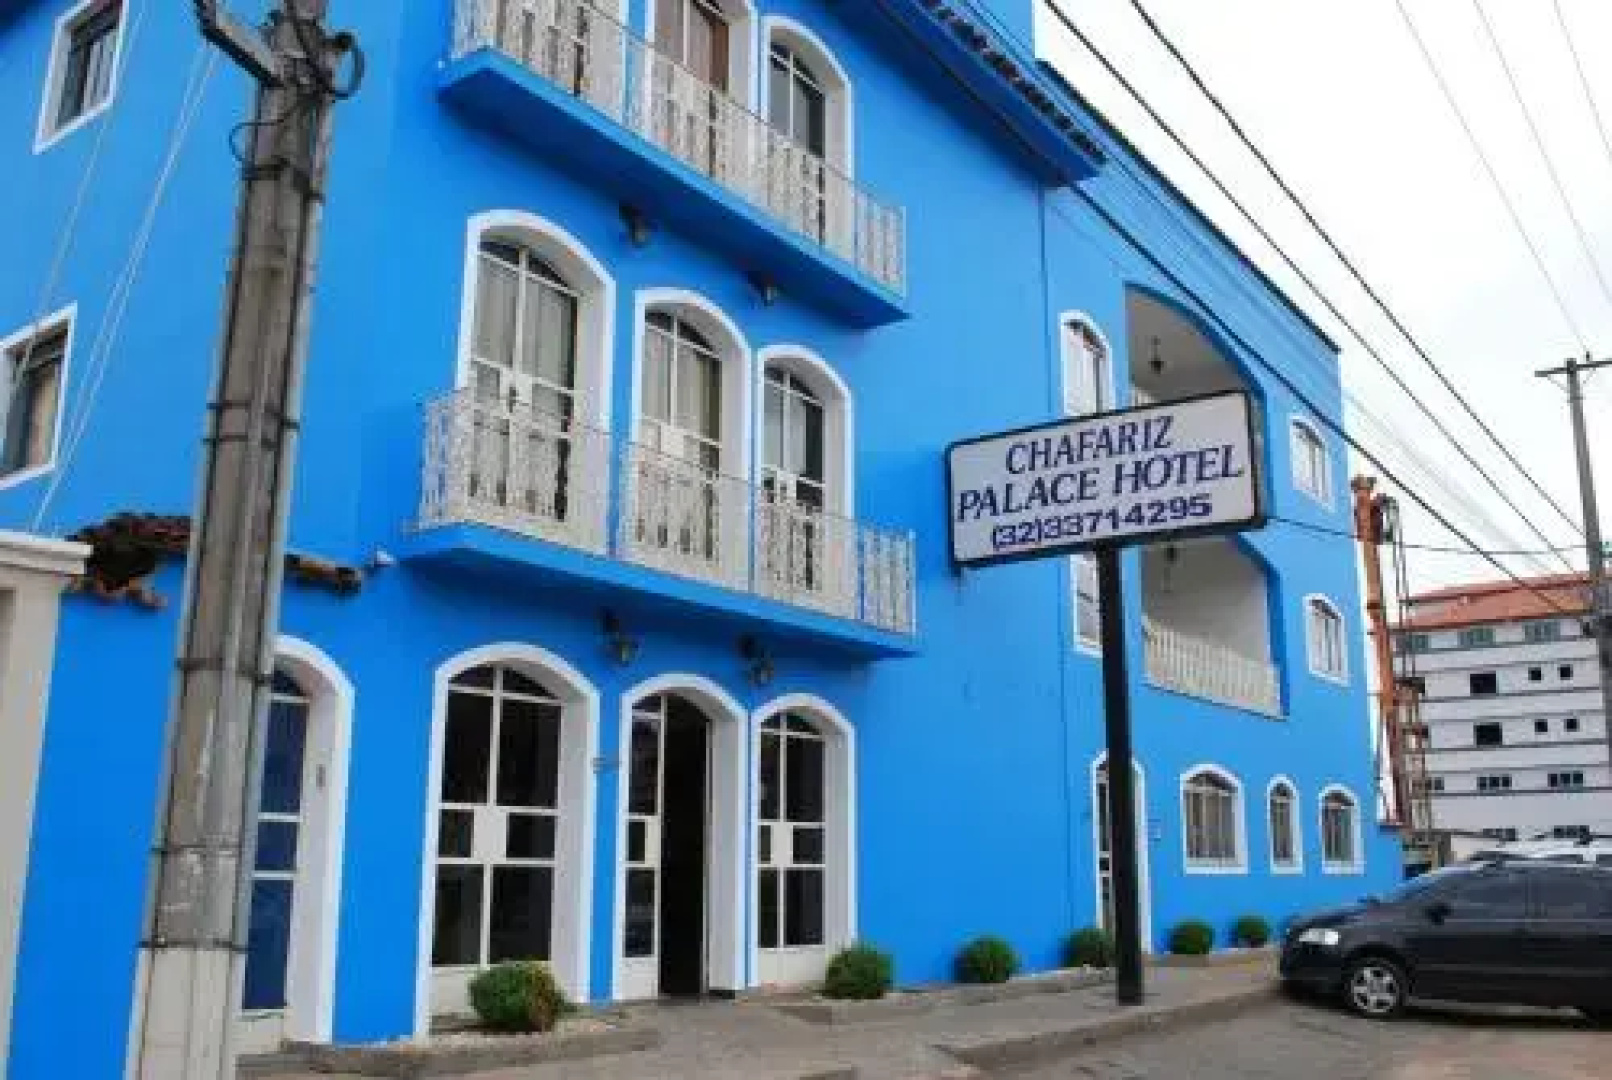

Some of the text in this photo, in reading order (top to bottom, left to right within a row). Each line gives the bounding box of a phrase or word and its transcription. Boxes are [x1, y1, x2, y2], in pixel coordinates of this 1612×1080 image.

[1006, 416, 1173, 475] CHAFARIZ
[957, 445, 1244, 522] PALACE HOTEL
